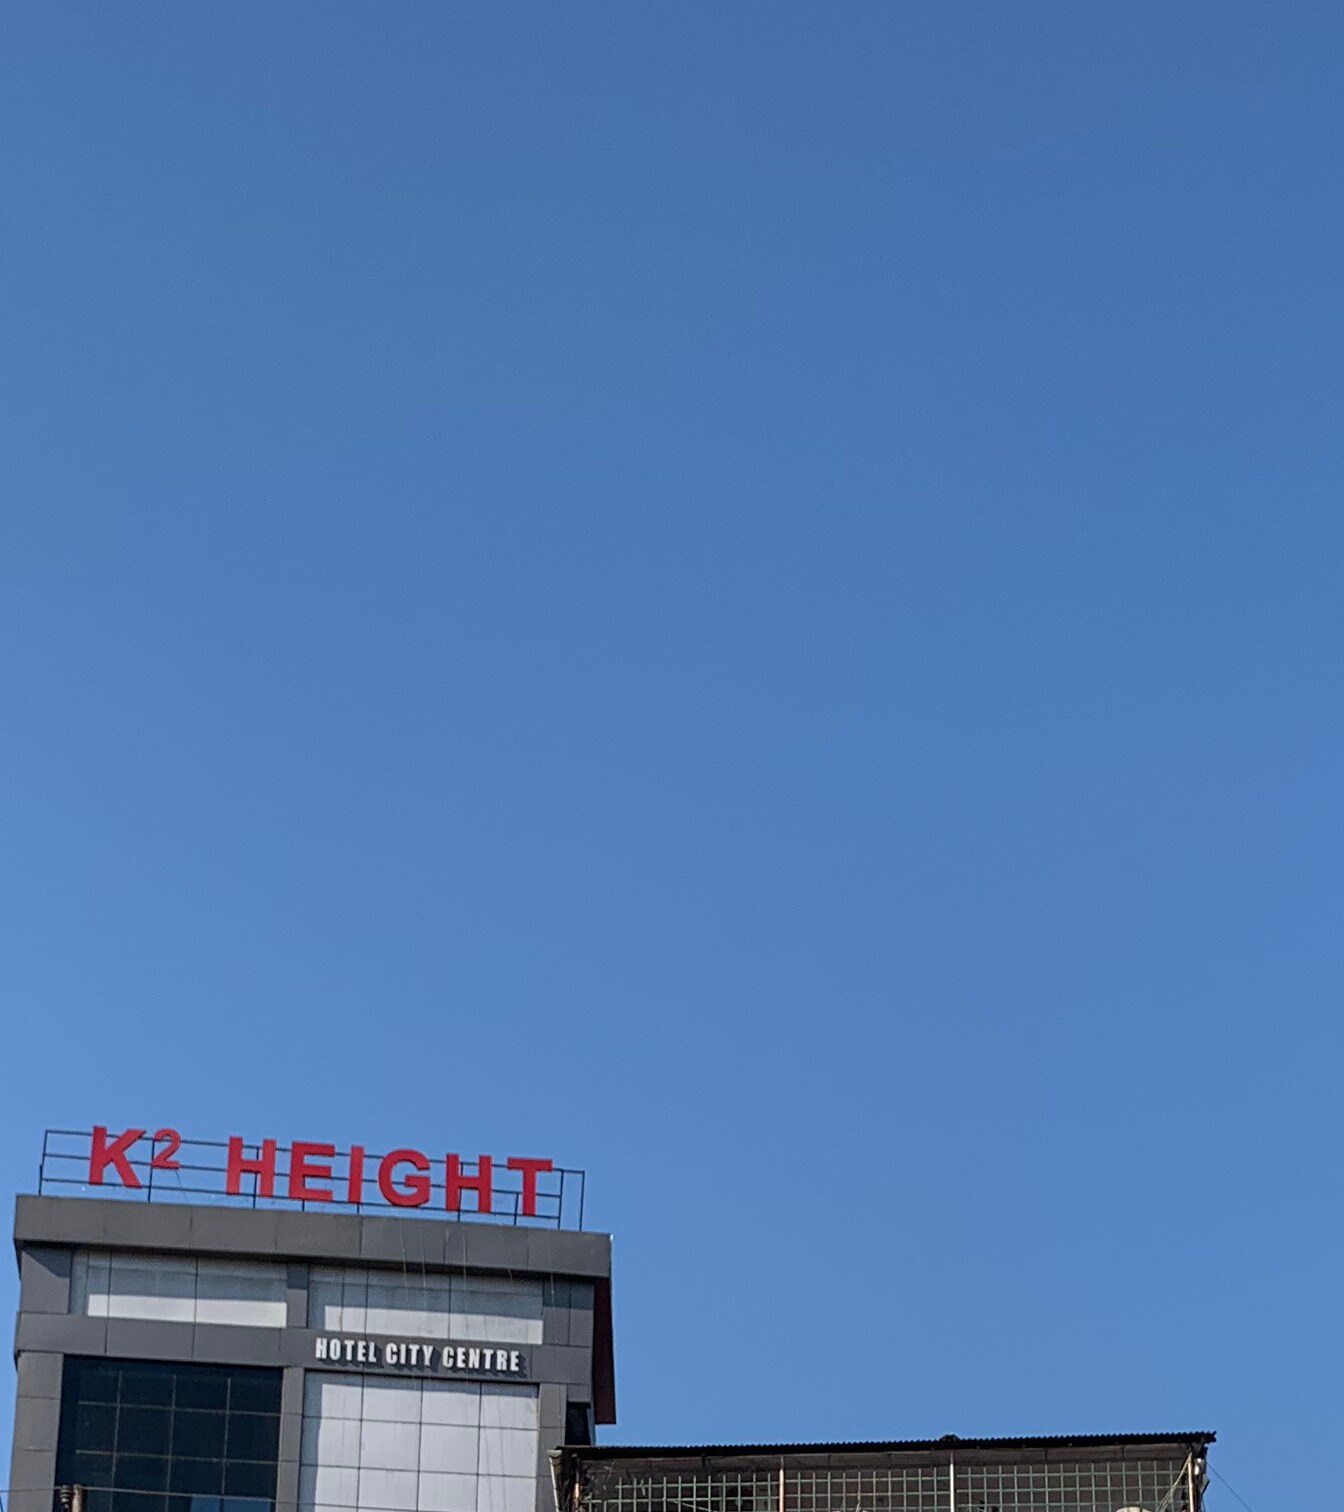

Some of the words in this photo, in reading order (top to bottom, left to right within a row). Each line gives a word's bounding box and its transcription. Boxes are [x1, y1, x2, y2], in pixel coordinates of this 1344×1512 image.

[226, 1136, 553, 1216] HEIGHT
[315, 1337, 378, 1363] HOTEL
[385, 1342, 433, 1367] CITY
[442, 1347, 520, 1372] CENTRE
